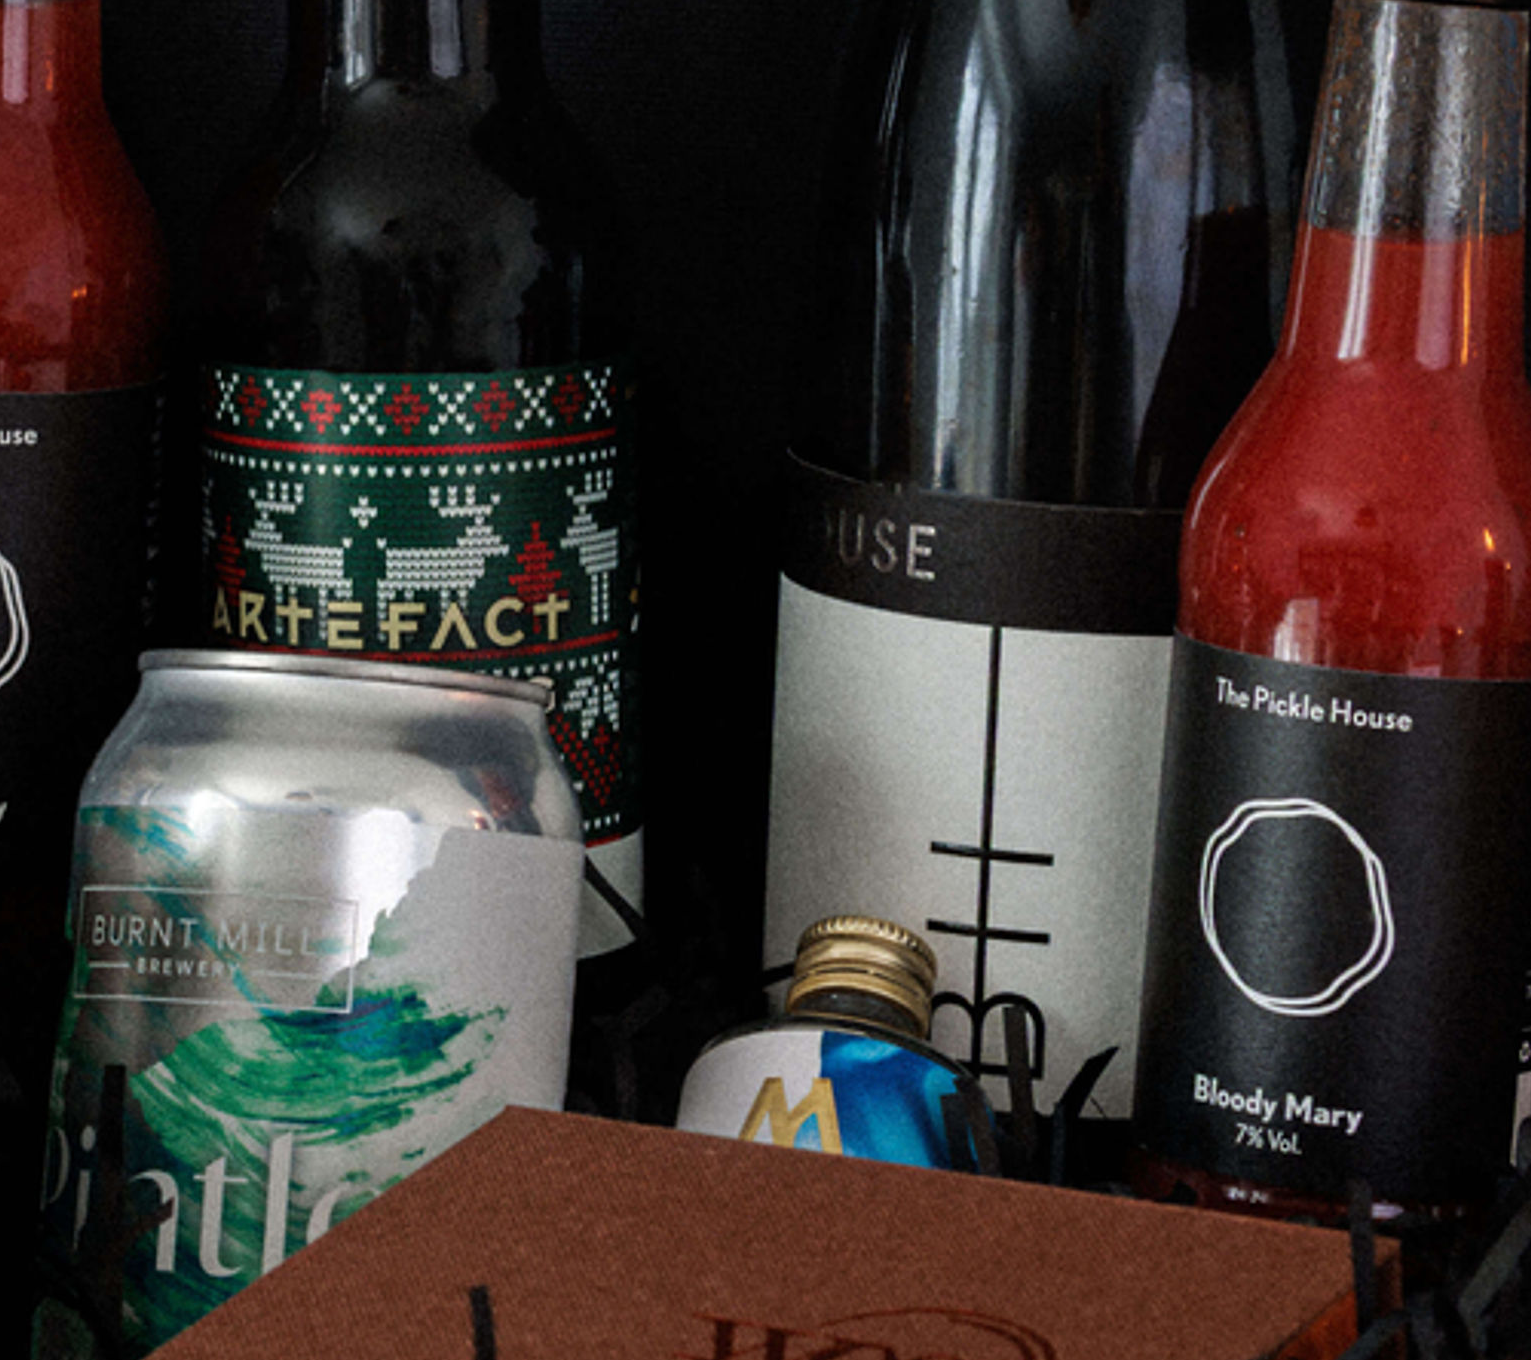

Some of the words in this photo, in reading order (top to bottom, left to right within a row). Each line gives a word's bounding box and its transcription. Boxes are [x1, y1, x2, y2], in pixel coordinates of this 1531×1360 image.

[824, 509, 938, 582] USE
[1214, 675, 1250, 710] The
[1254, 684, 1325, 724] Pickle
[1330, 699, 1414, 732] House
[90, 912, 200, 949] BURNT
[215, 922, 316, 957] MILL
[137, 955, 240, 979] BREWERY
[1192, 1072, 1279, 1121] Bloody
[1283, 1093, 1364, 1136] Mary
[1234, 1121, 1265, 1150] 7%
[1265, 1129, 1302, 1156] Vol.
